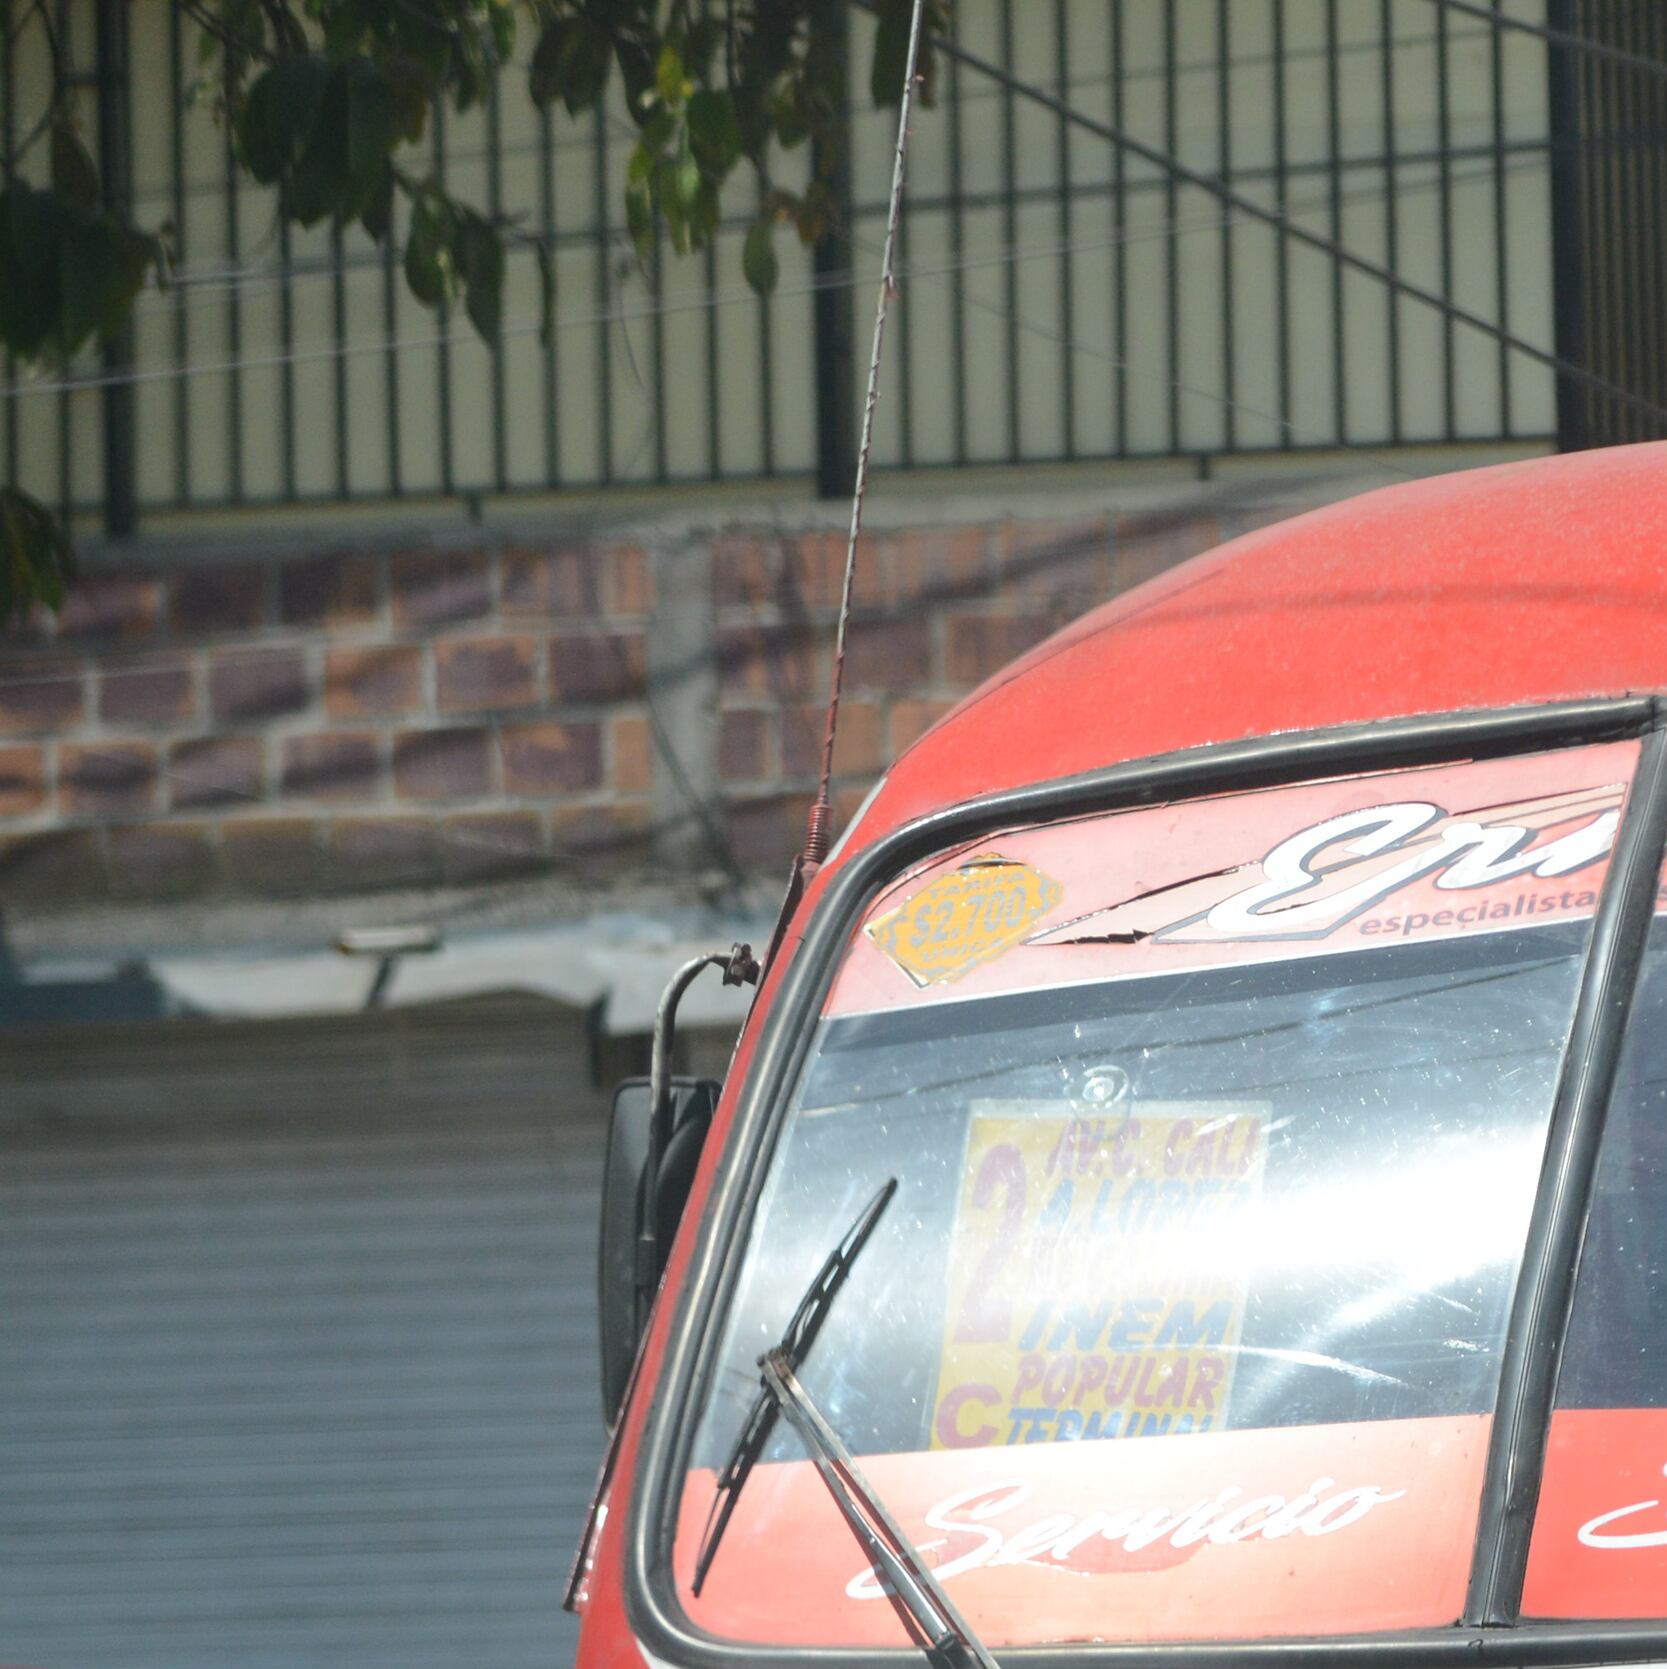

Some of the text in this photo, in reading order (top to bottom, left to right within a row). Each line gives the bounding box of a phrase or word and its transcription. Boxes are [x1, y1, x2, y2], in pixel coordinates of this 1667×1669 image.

[954, 1142, 1027, 1344] 2
[1018, 1298, 1234, 1352] INEM
[1010, 1353, 1225, 1408] POPULAR
[936, 1383, 1002, 1448] C
[845, 1477, 1407, 1600] Servicio
